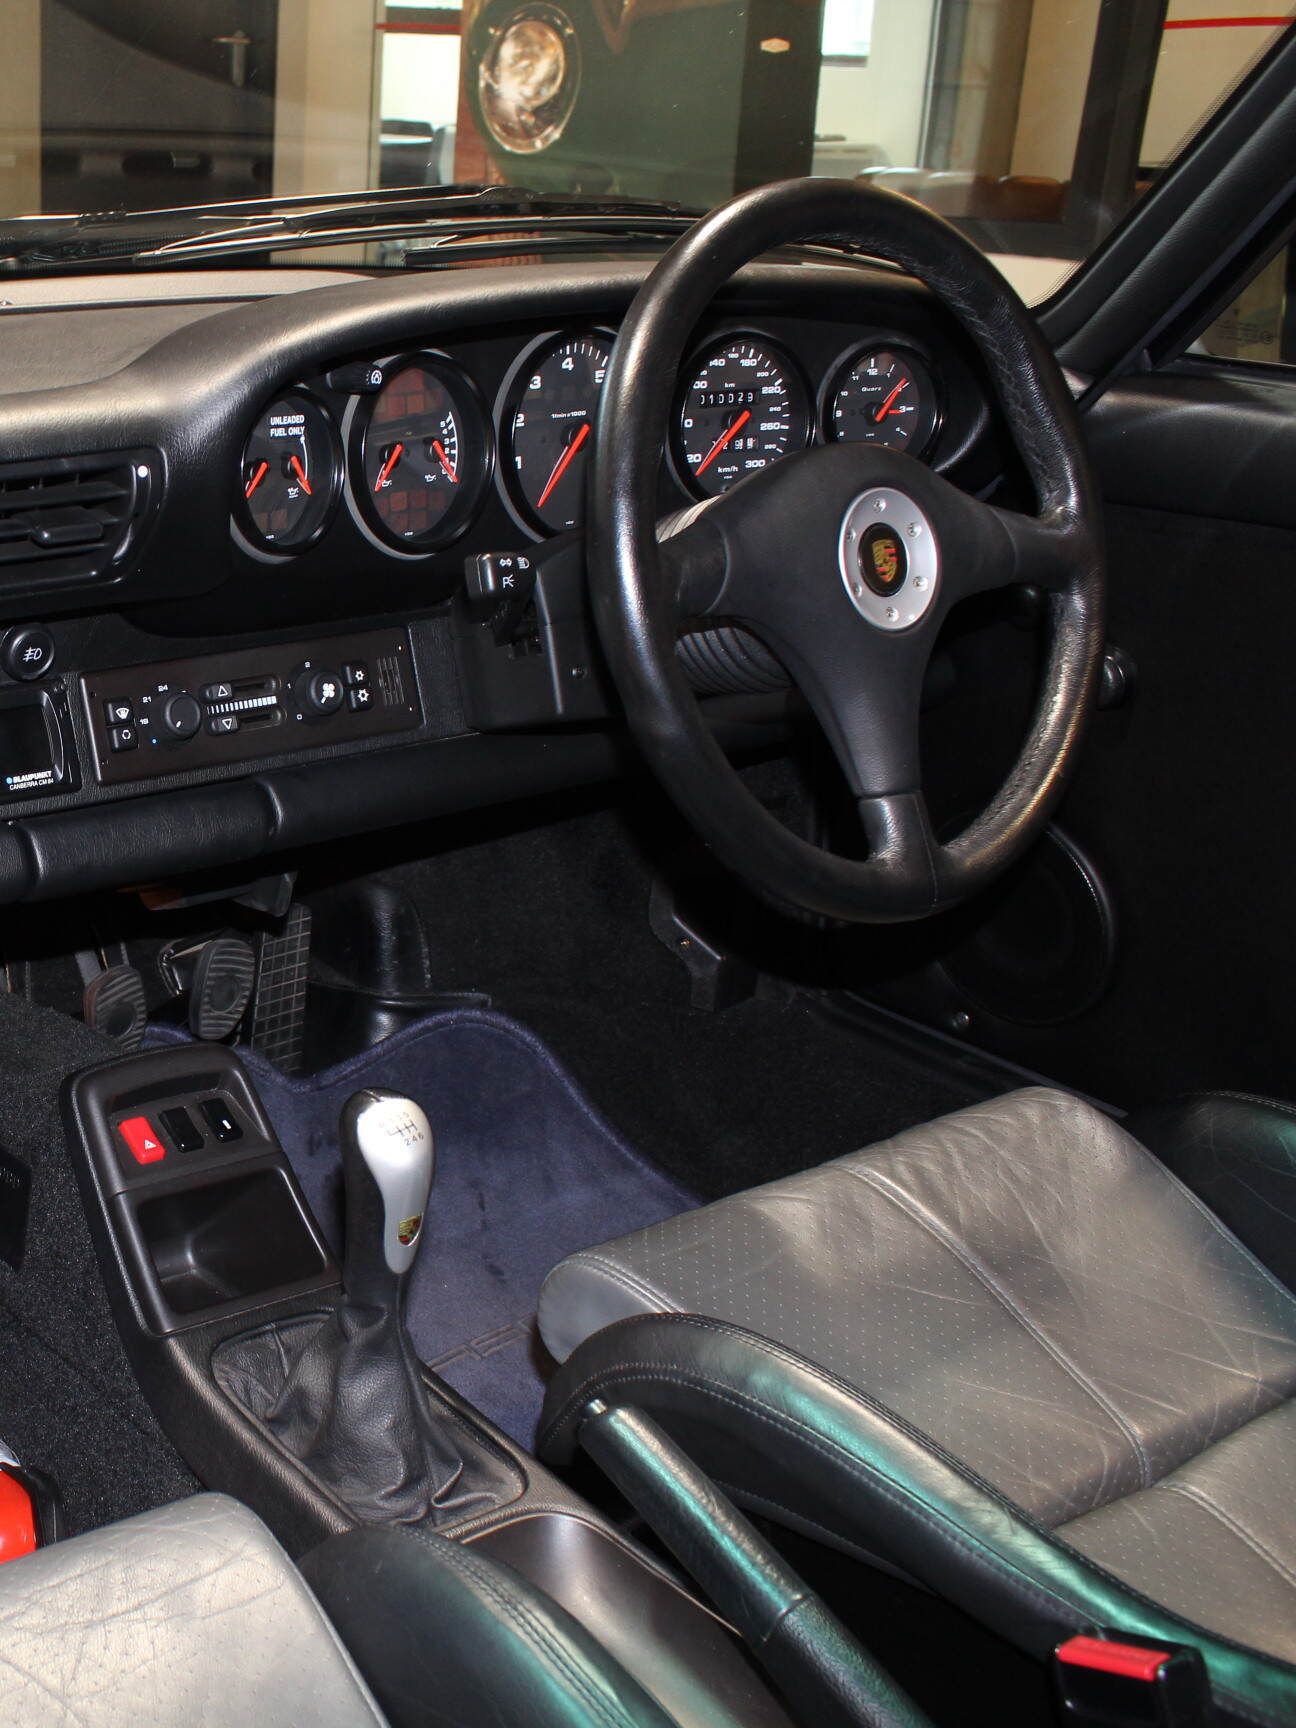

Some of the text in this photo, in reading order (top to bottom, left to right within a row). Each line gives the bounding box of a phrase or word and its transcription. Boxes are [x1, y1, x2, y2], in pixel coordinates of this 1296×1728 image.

[561, 357, 574, 371] 4
[594, 370, 605, 383] 5
[529, 376, 541, 389] 3
[761, 386, 781, 394] 220
[270, 414, 305, 425] UNLEADED
[835, 410, 842, 418] 9
[515, 413, 525, 427] 2
[270, 426, 305, 437] FUEL ONLY
[515, 456, 522, 470] 1
[745, 460, 765, 468] 300
[157, 684, 169, 692] 24
[12, 770, 52, 783] BLAUPUNKT
[9, 780, 39, 791] CANBERRA
